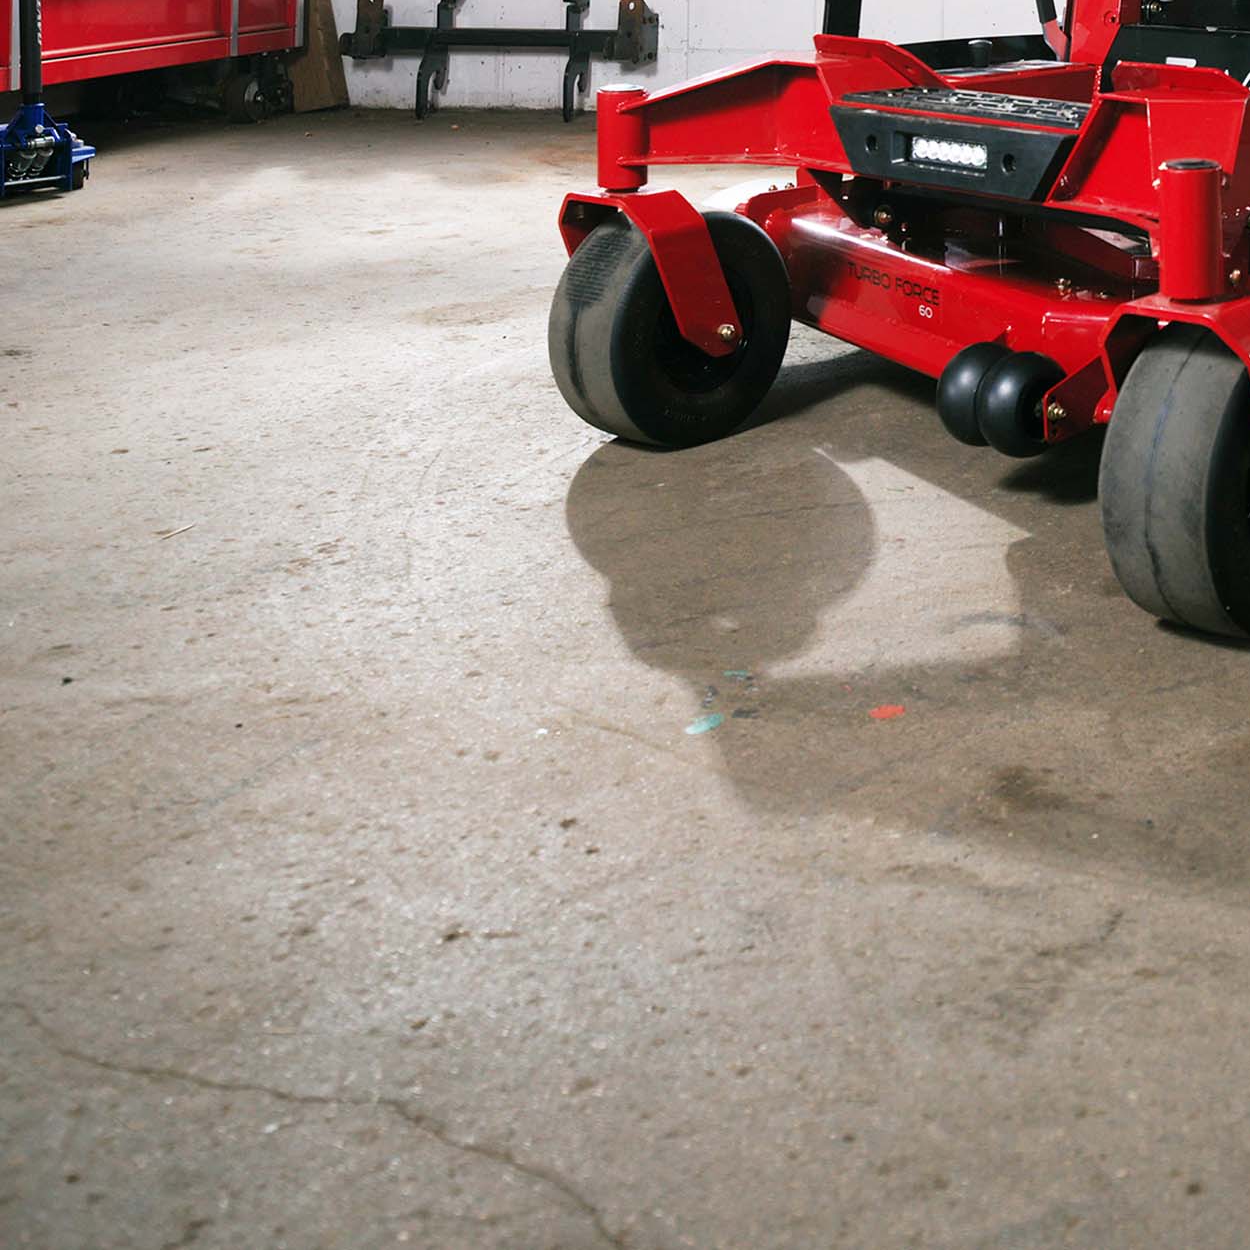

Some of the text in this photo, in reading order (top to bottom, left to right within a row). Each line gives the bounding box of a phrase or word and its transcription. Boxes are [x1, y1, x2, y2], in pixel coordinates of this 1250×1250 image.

[848, 261, 940, 306] TURBO FORCE
[918, 304, 933, 319] 60
